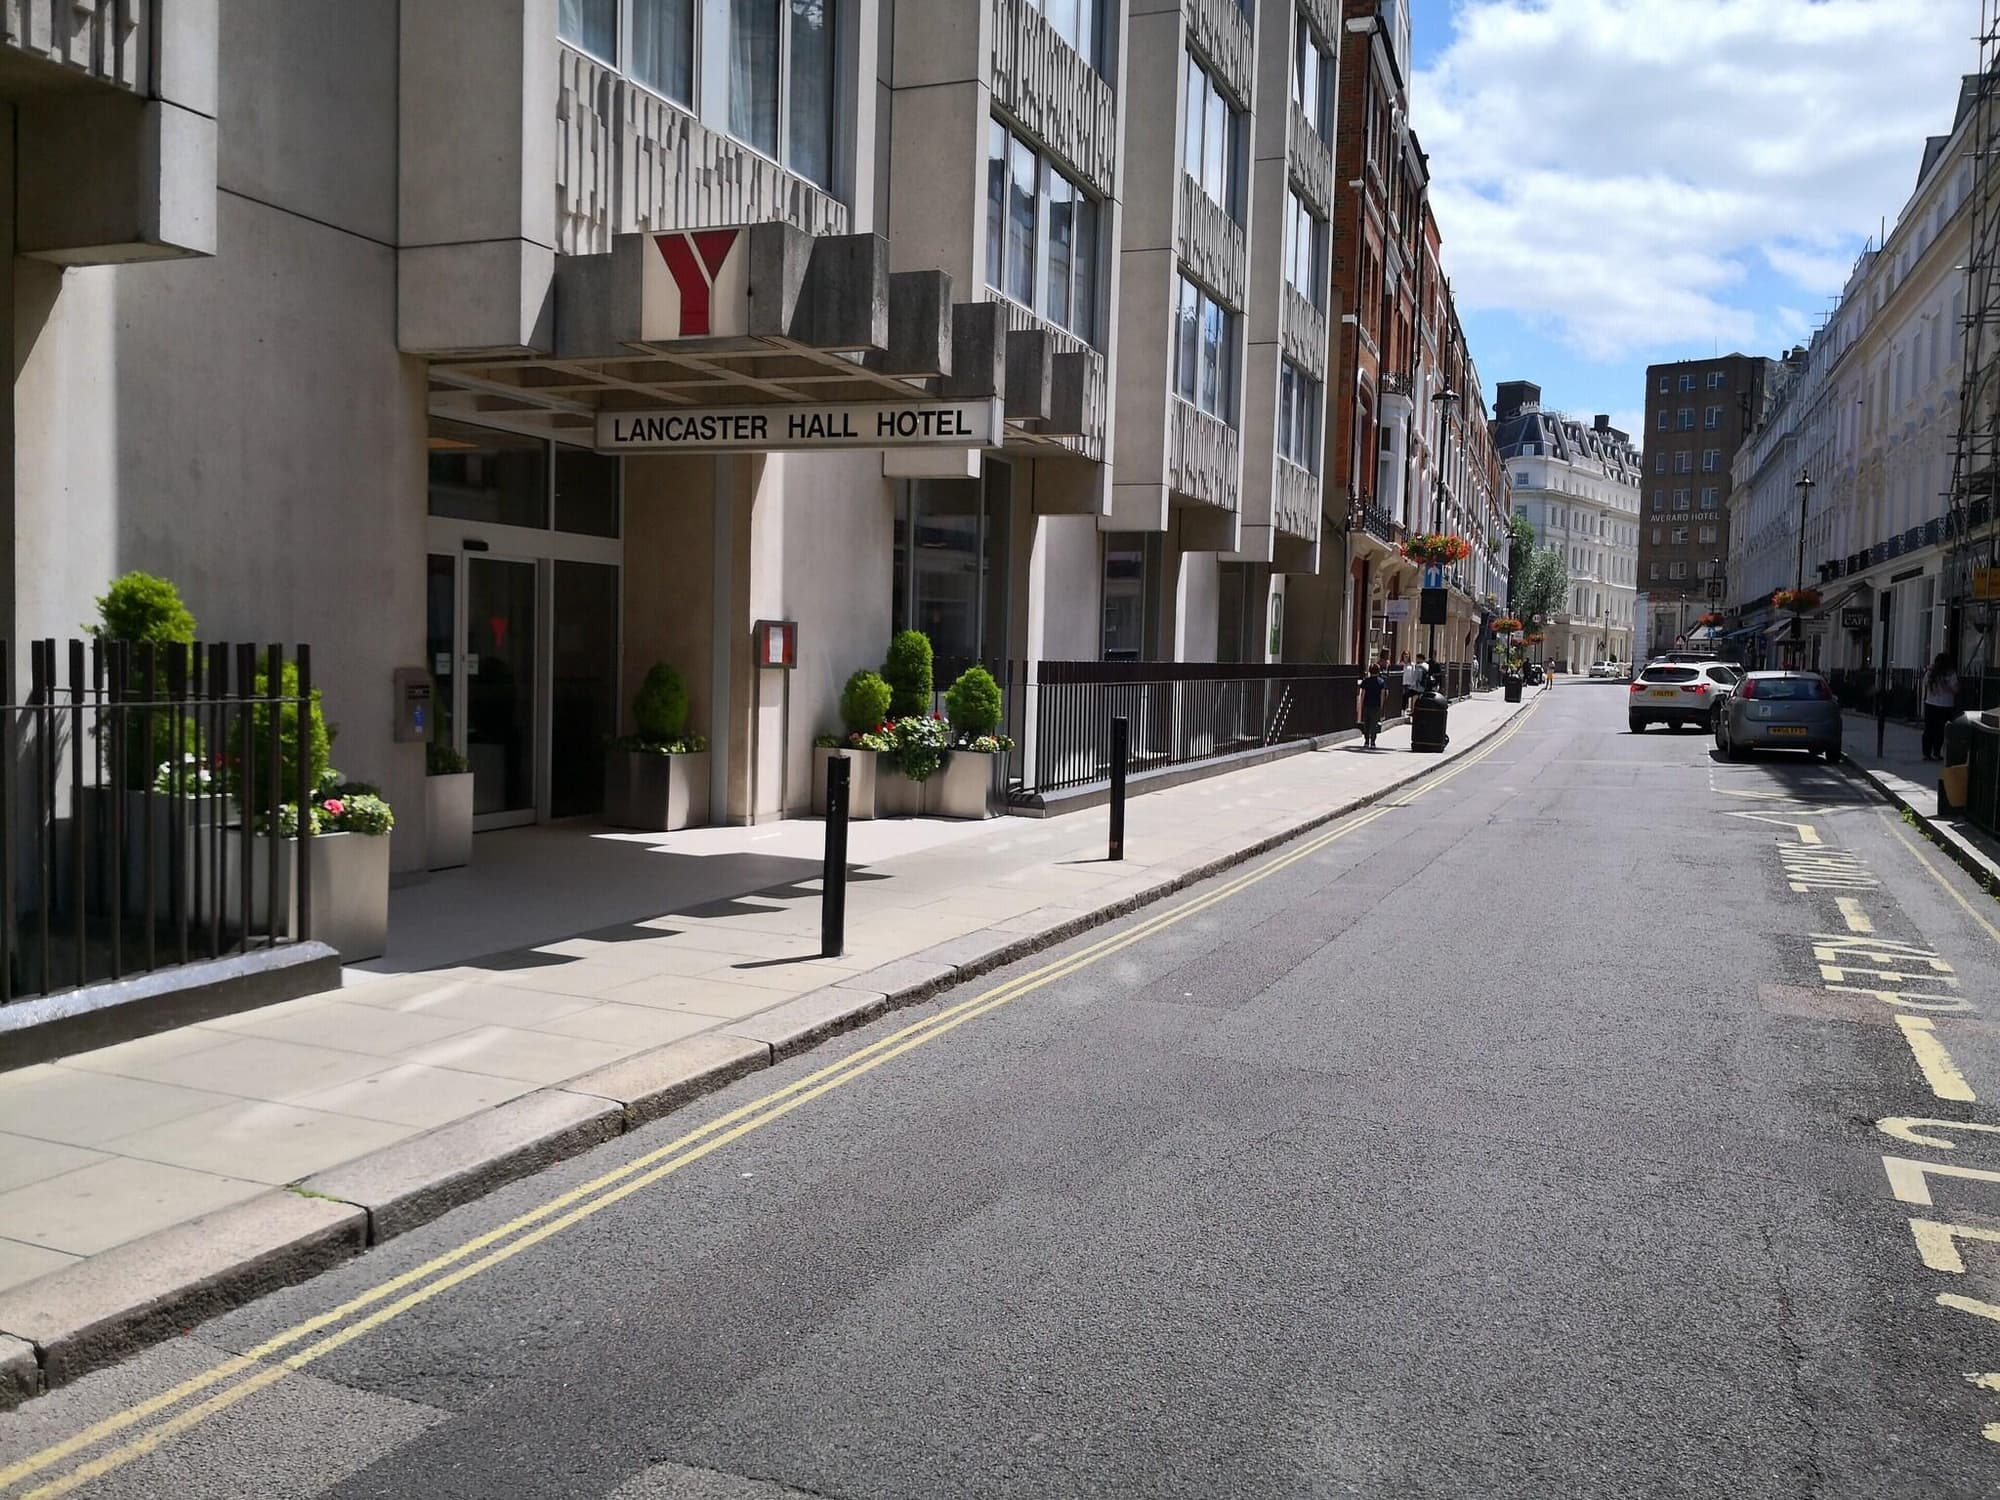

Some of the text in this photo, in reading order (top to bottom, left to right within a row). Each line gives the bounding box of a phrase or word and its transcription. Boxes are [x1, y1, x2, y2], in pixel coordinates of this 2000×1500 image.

[653, 228, 740, 337] Y
[614, 409, 973, 443] LANCASTER HALL HOTEL
[1691, 511, 1720, 521] HOTEL
[1808, 931, 1973, 1011] KEEP
